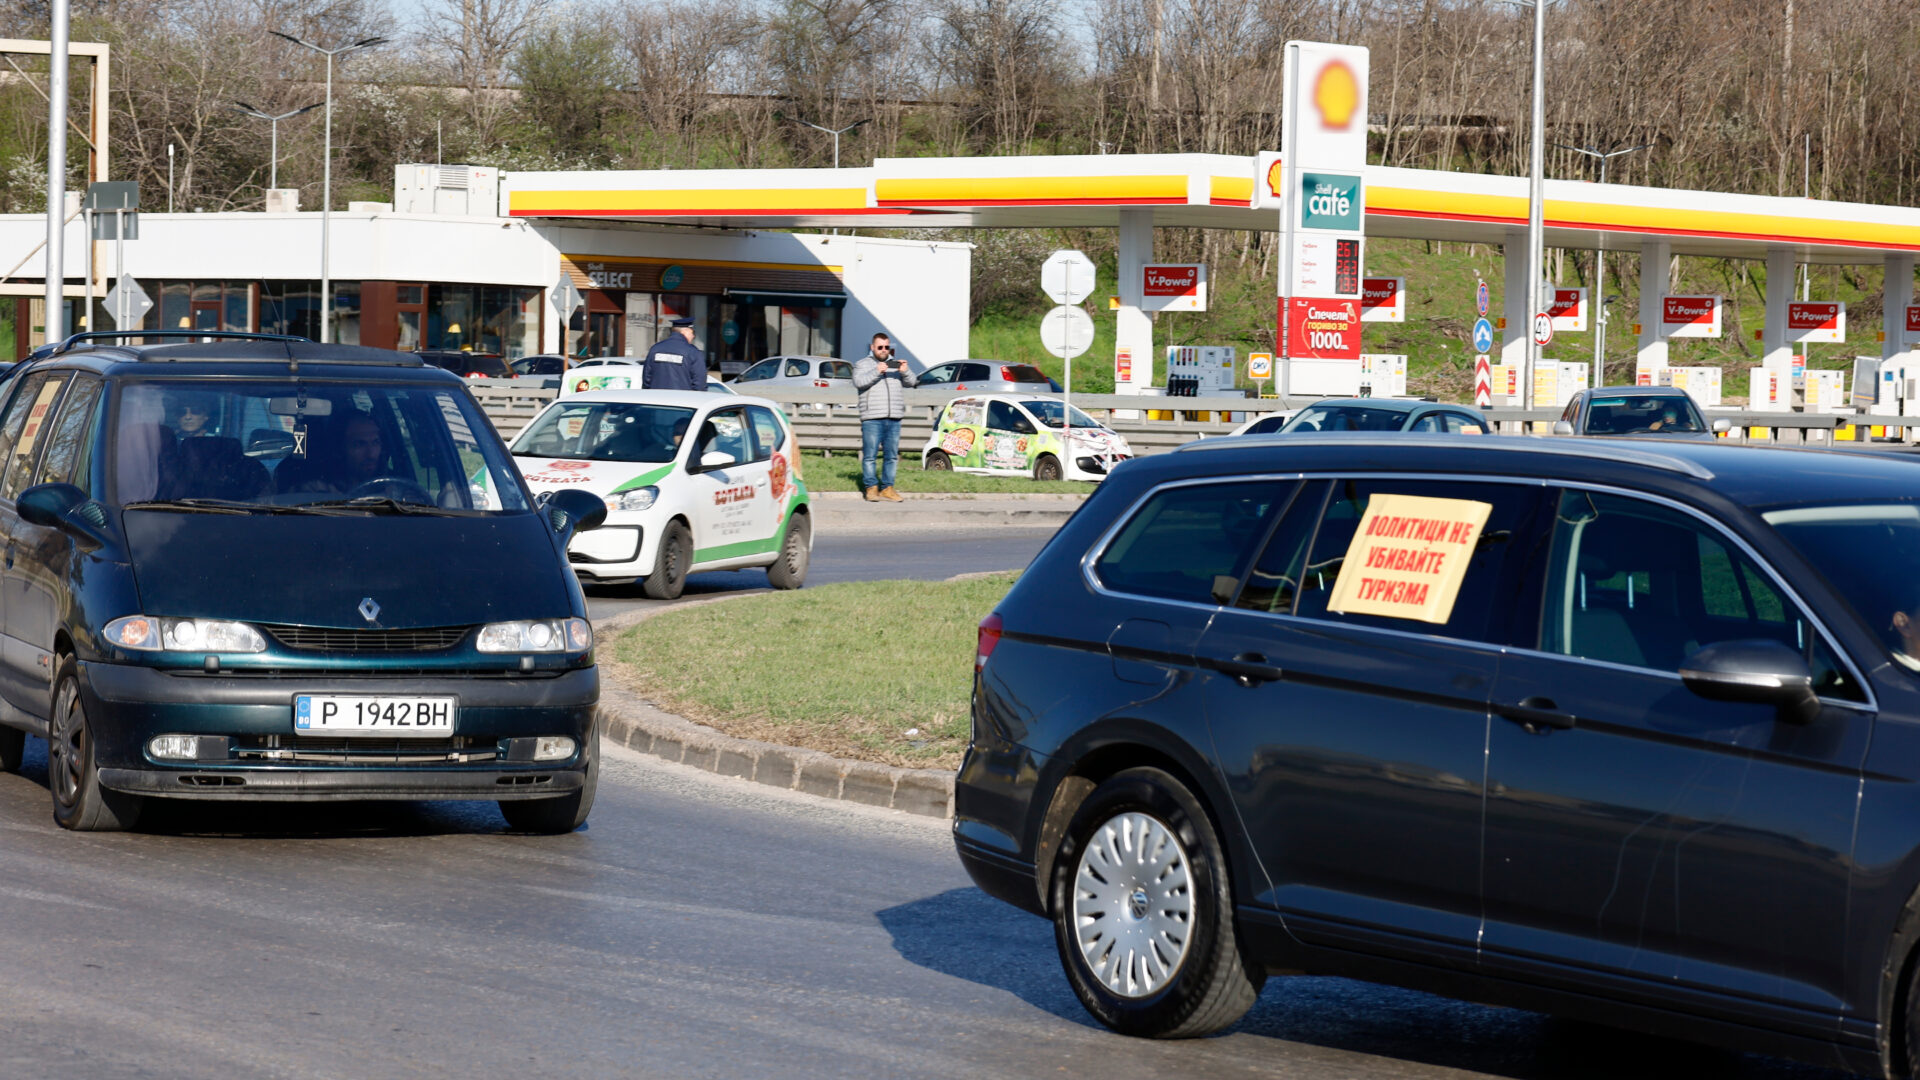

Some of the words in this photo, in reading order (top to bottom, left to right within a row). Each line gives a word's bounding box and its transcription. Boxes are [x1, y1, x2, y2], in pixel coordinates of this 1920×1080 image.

[1315, 183, 1332, 195] Shell
[1309, 188, 1350, 216] café
[588, 271, 632, 288] SELECT
[1148, 276, 1192, 287] V-Power
[1308, 307, 1349, 321] Спечели
[1668, 305, 1709, 315] V-Power
[1792, 311, 1833, 321] V-Power
[1307, 322, 1337, 332] гориво
[1337, 323, 1348, 331] за
[1310, 332, 1342, 350] 1000
[1365, 515, 1450, 544] ПОЛИТИЦИ
[1448, 521, 1475, 545] НЕ
[1364, 546, 1446, 575] УБИВАЙТЕ
[1357, 577, 1430, 606] ТУРИЗМА
[322, 702, 338, 725] P
